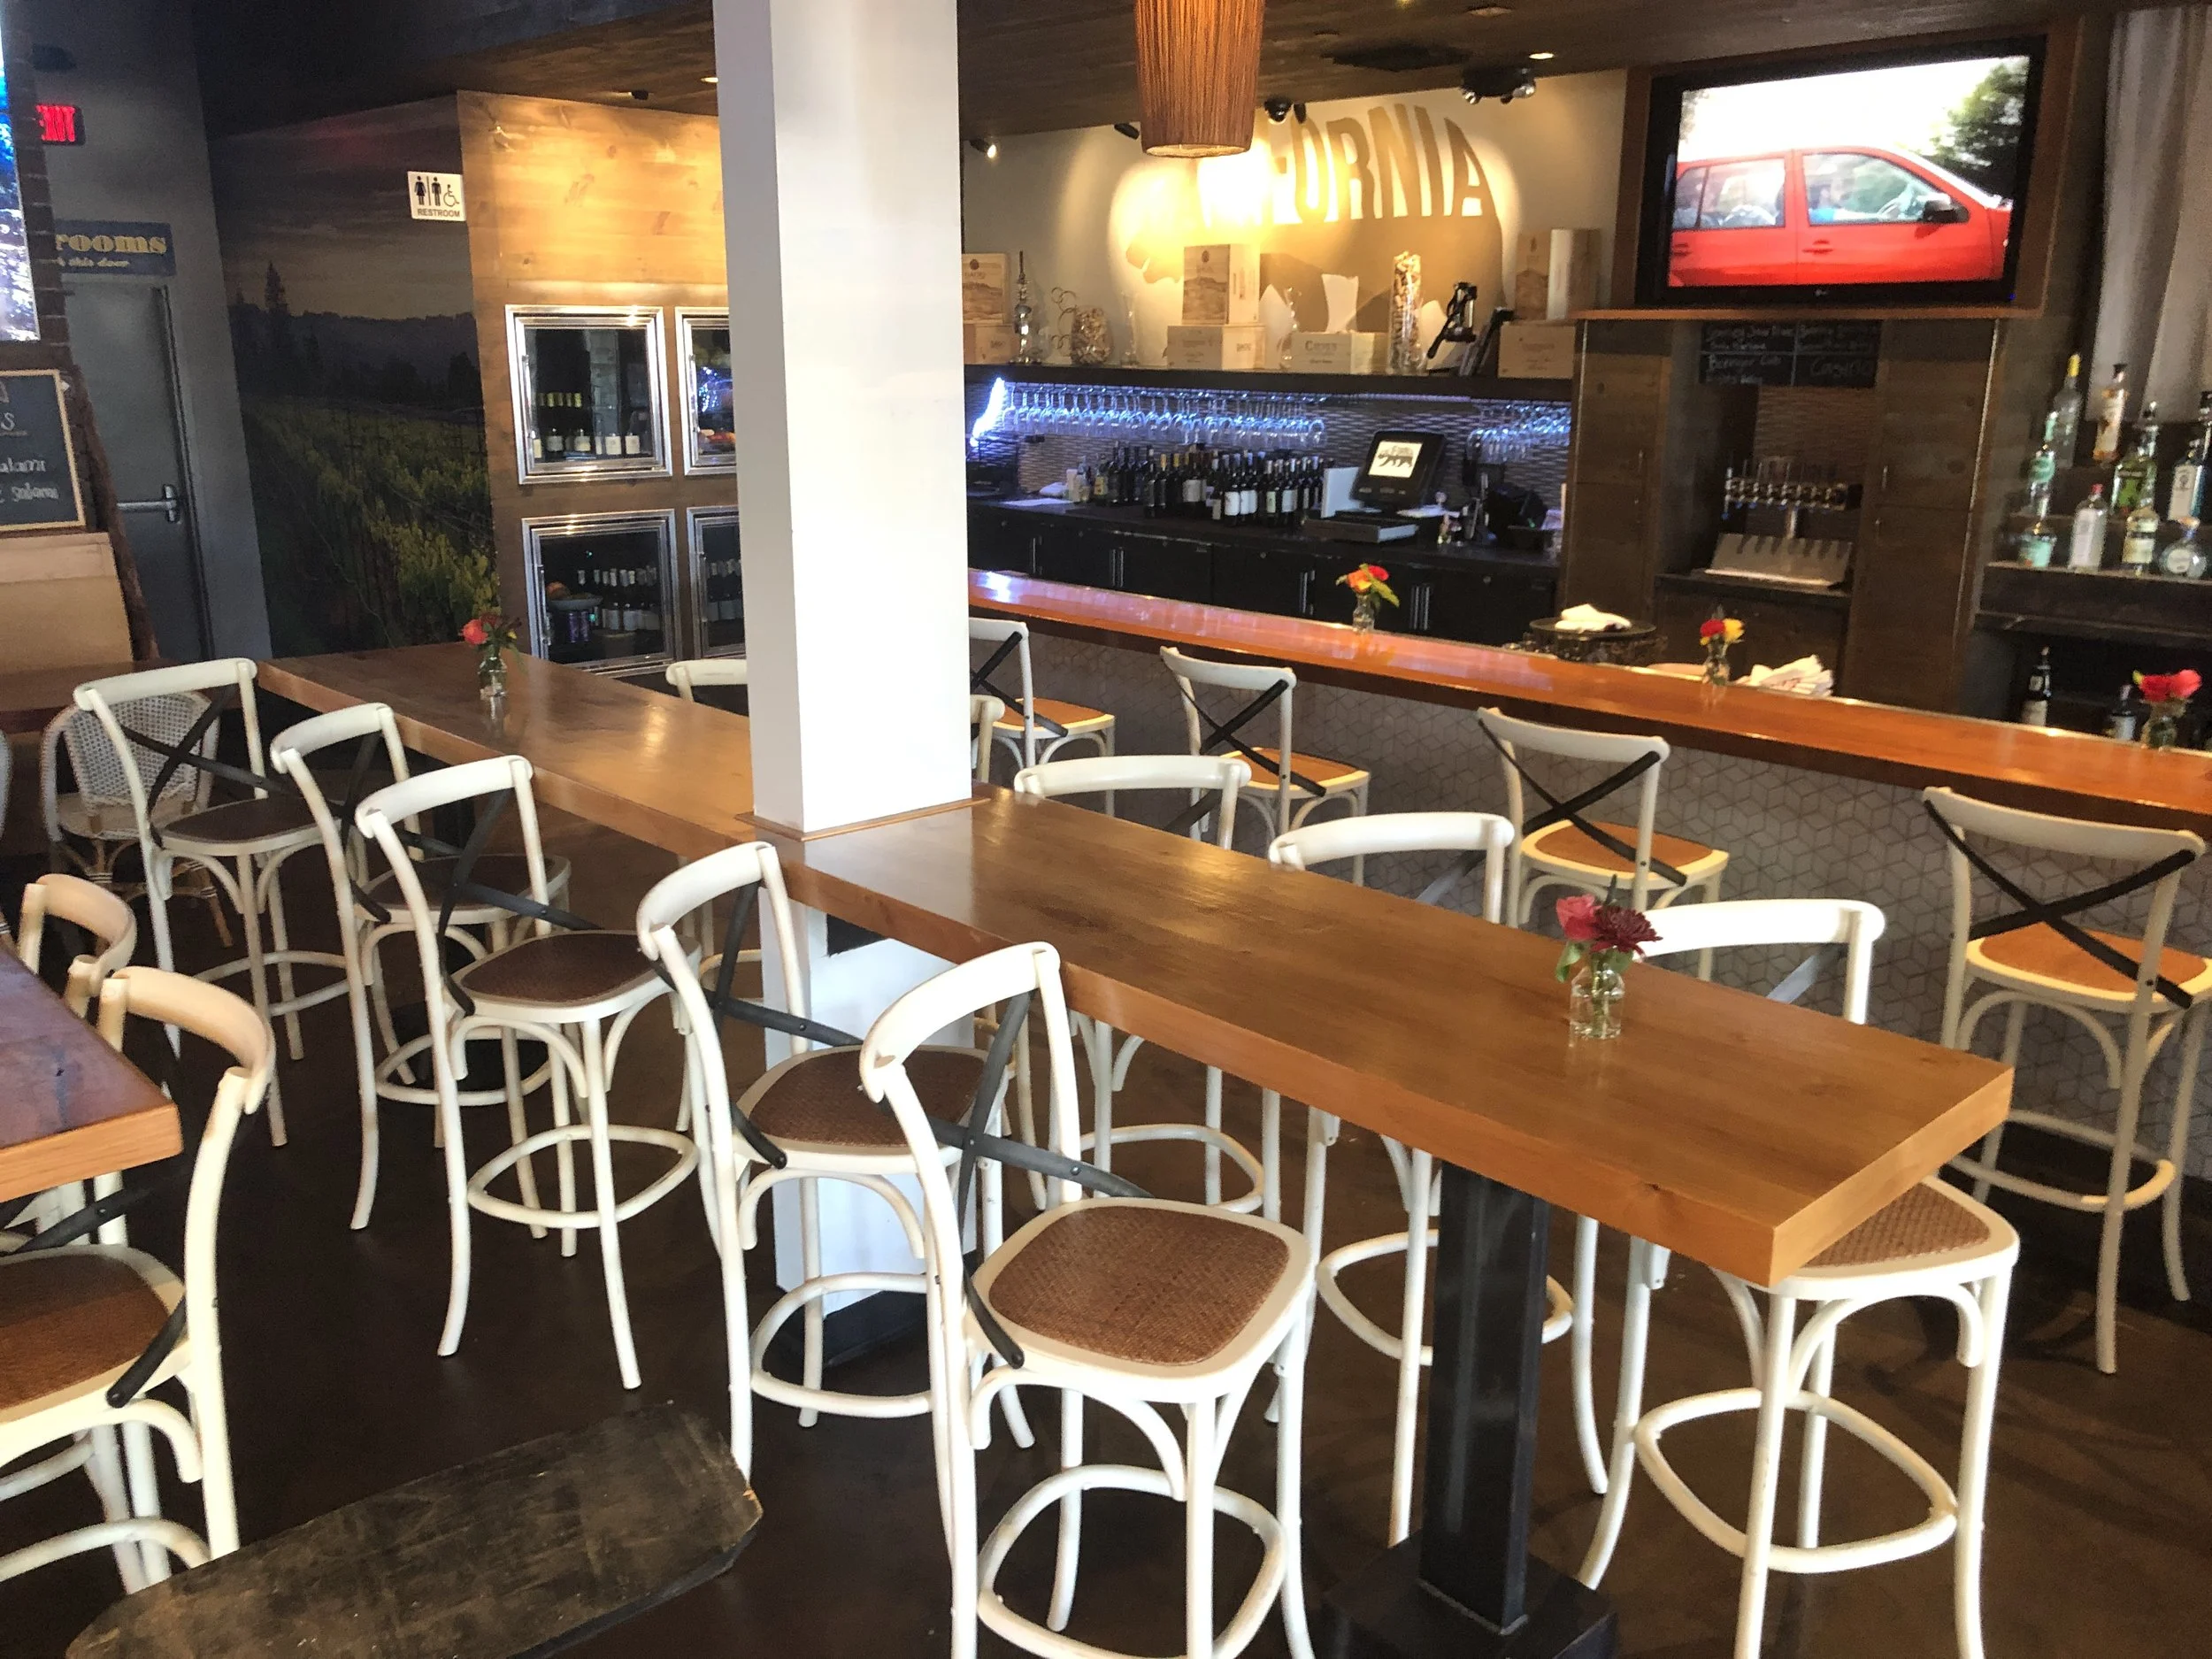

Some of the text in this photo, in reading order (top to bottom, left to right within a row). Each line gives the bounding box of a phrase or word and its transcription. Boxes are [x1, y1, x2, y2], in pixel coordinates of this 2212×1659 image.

[418, 208, 460, 218] RESTROOM
[55, 234, 167, 255] rooms
[0, 457, 46, 474] alami
